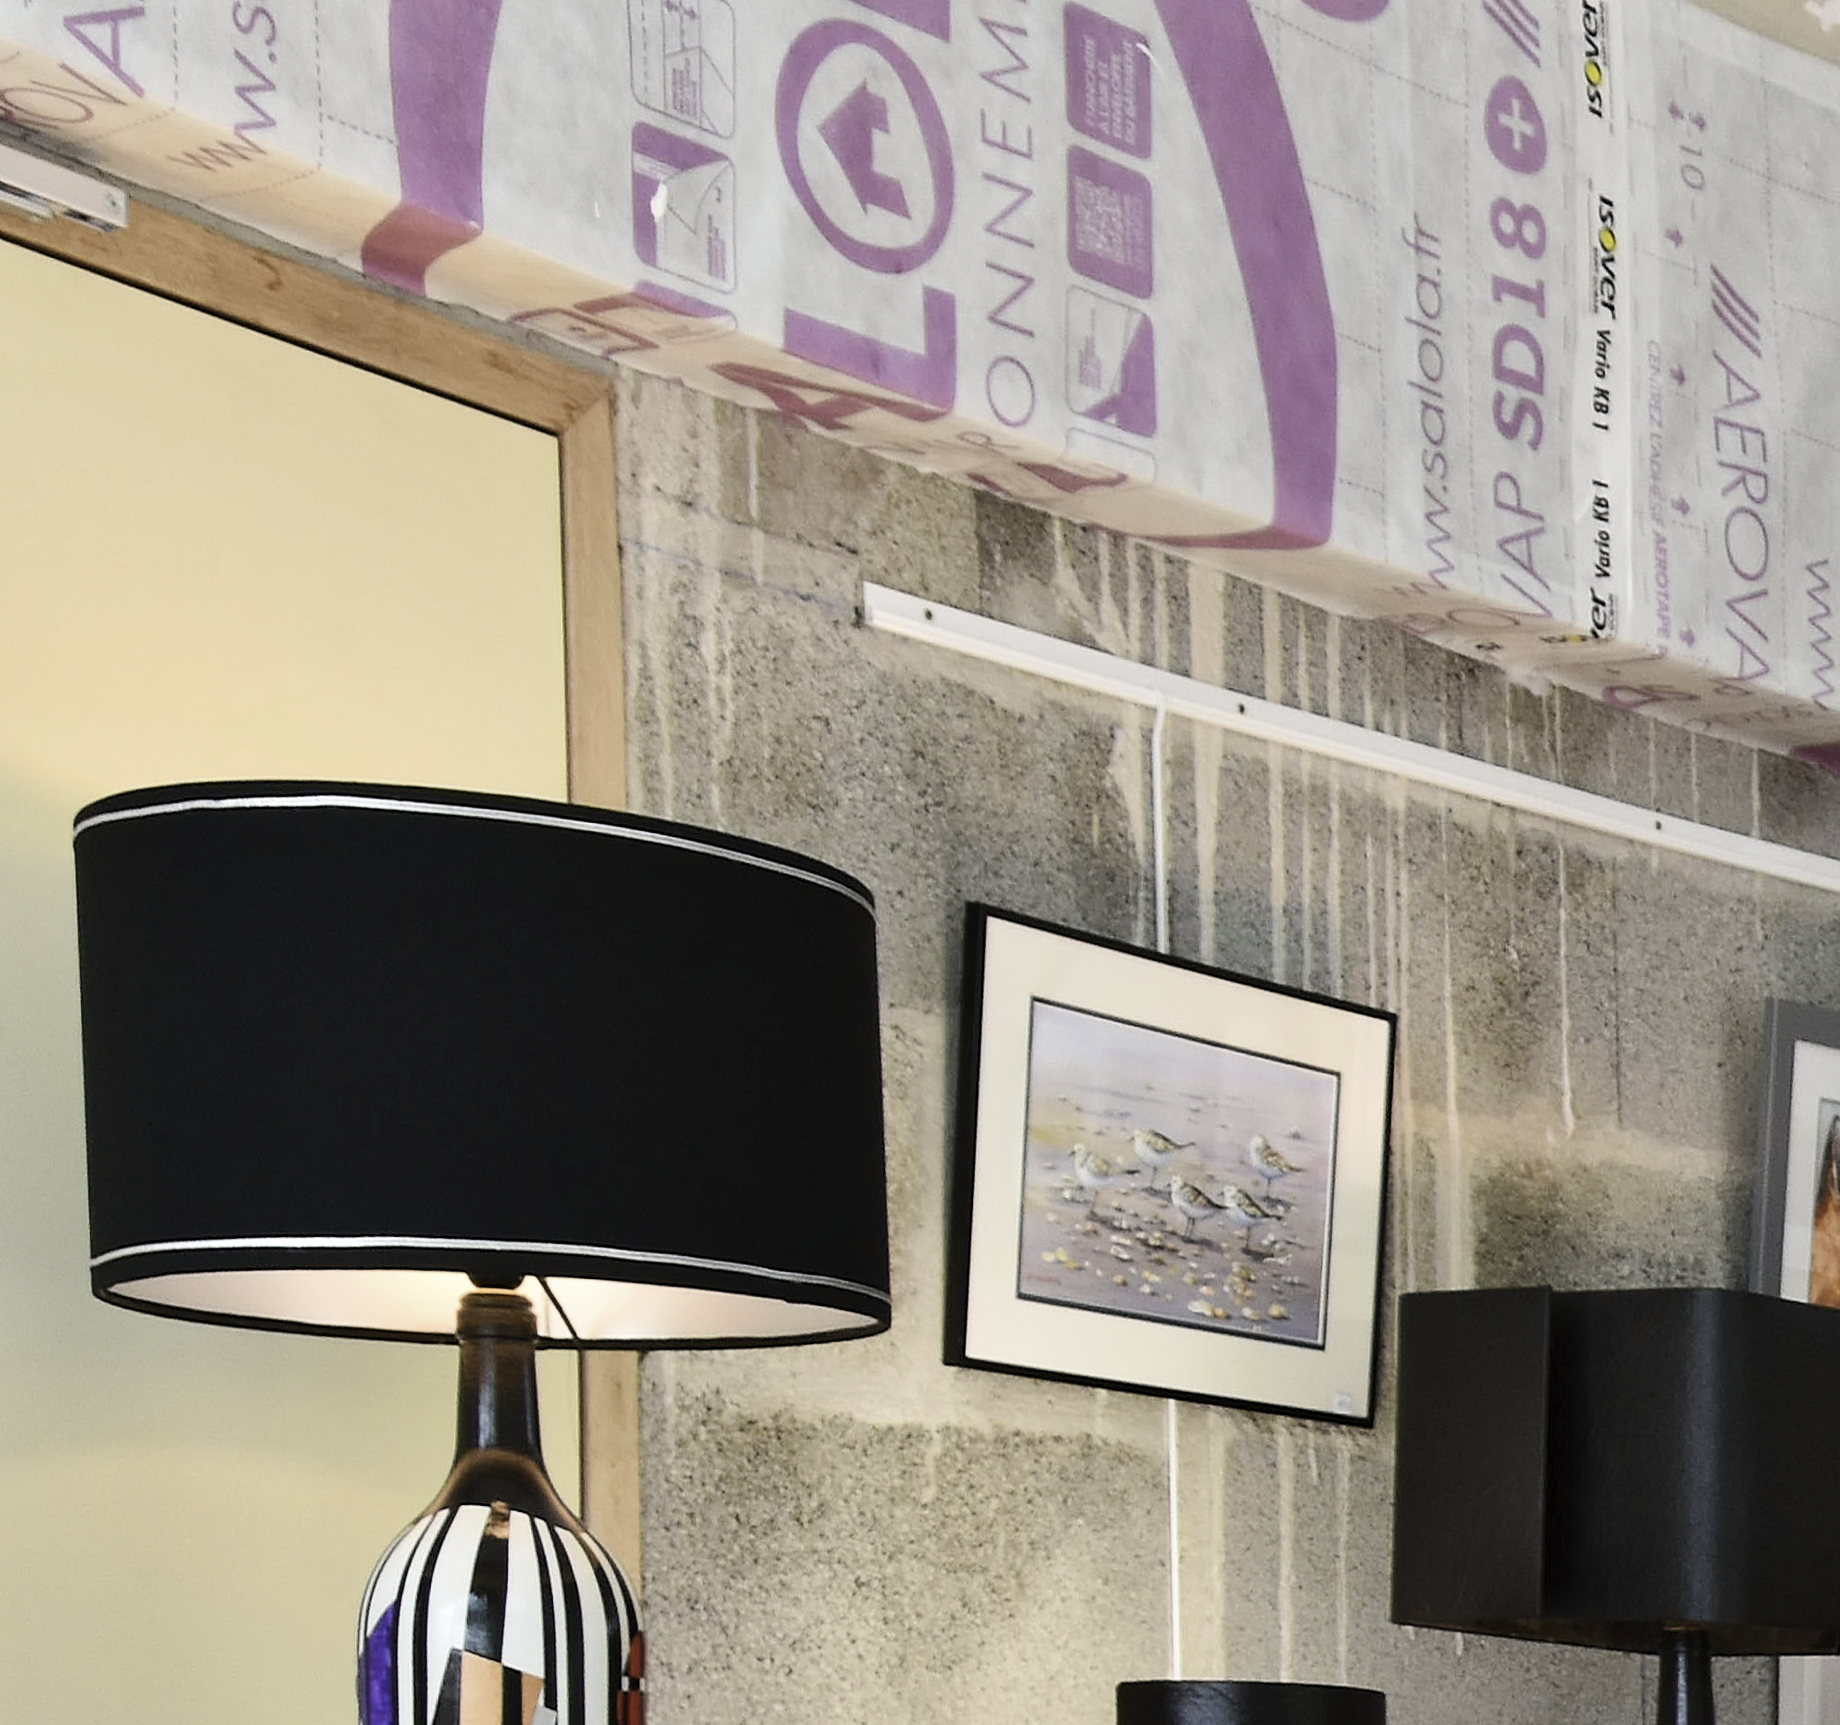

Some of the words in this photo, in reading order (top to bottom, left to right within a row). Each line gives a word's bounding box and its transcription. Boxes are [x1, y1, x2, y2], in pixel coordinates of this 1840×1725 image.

[1594, 328, 1613, 379] Vario
[1593, 386, 1612, 416] KB
[1593, 531, 1613, 580] Vario
